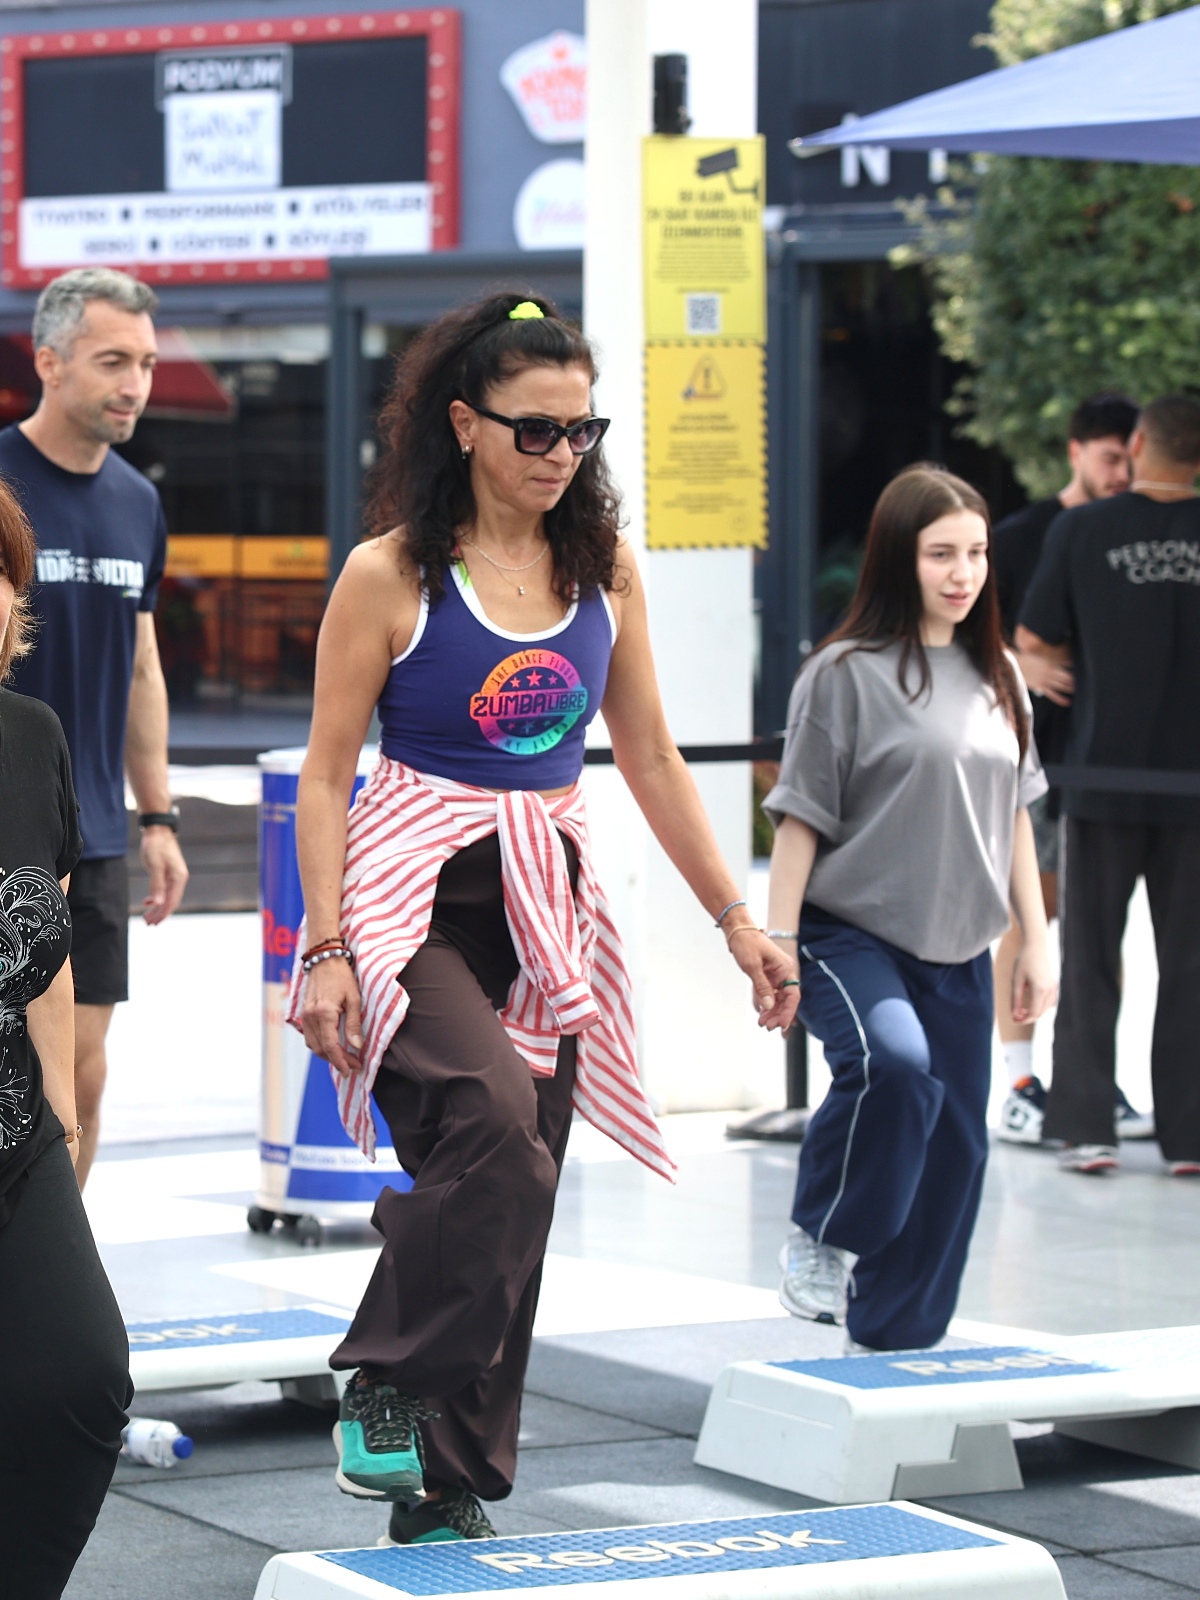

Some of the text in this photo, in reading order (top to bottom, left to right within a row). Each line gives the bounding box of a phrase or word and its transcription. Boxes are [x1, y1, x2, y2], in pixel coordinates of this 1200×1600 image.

[1106, 539, 1200, 571] PERSON
[491, 666, 509, 686] THE
[511, 653, 543, 668] DANCE
[471, 1529, 848, 1574] Reebok
